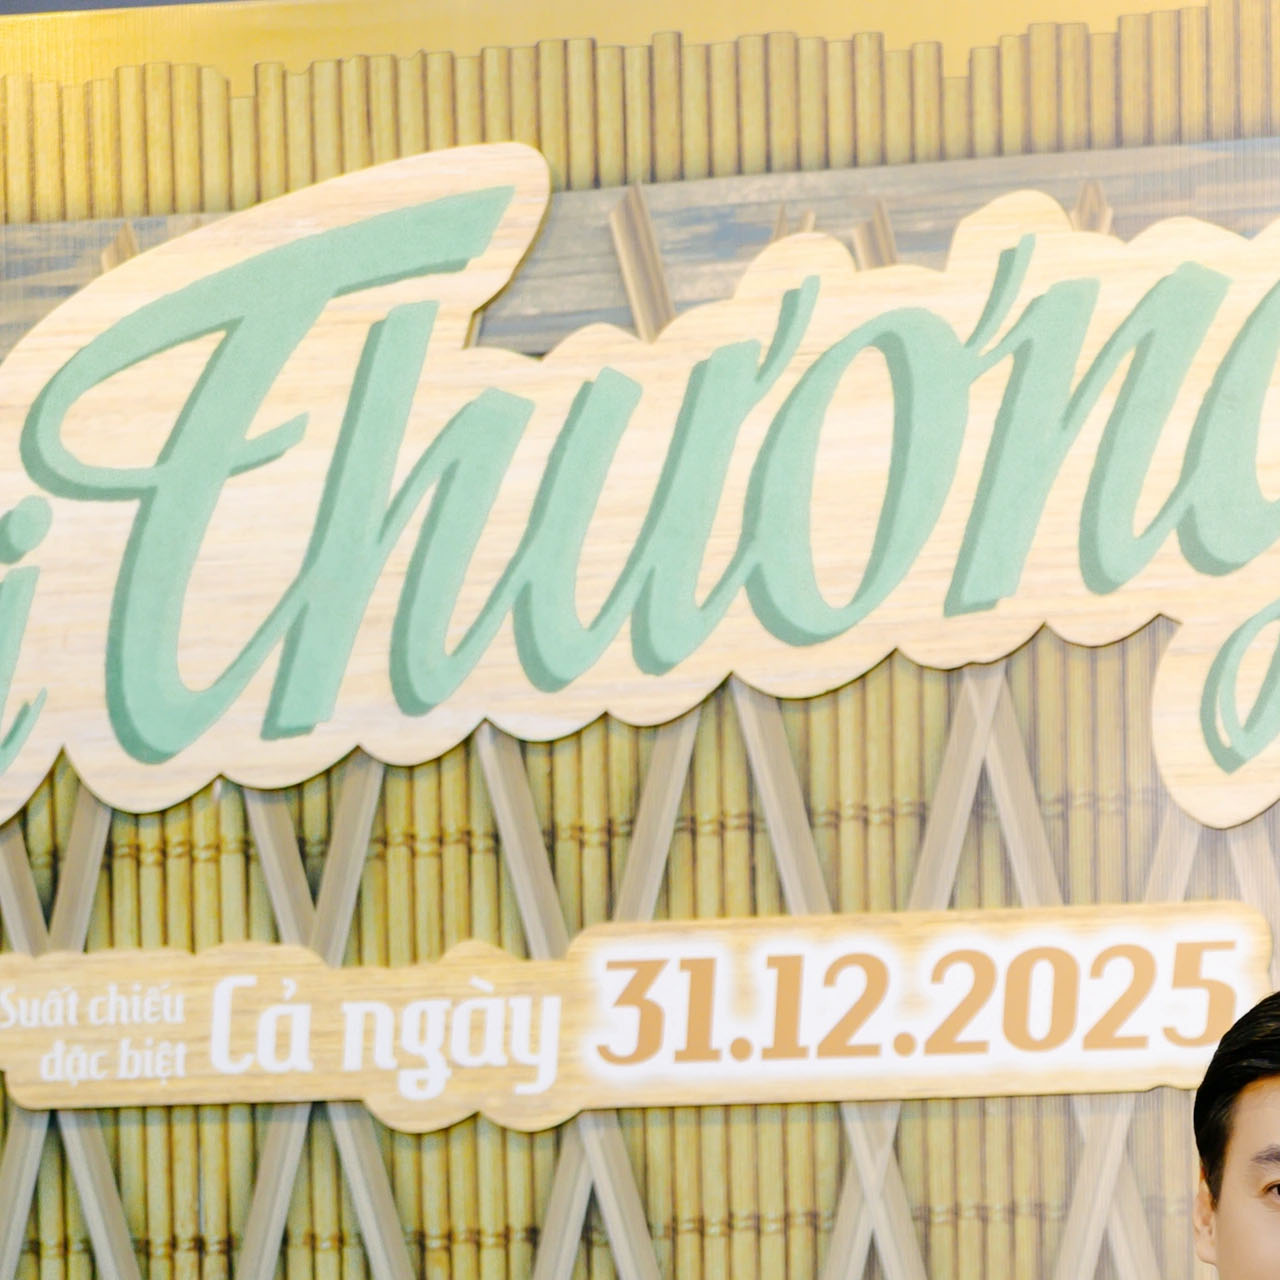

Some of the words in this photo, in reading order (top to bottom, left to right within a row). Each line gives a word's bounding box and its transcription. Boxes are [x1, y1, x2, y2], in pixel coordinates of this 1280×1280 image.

[88, 980, 186, 1025] chiếu
[210, 976, 313, 1074] Cả
[342, 976, 562, 1100] ngày
[596, 940, 1238, 1067] 31.12.2025
[117, 1036, 188, 1087] biệt
